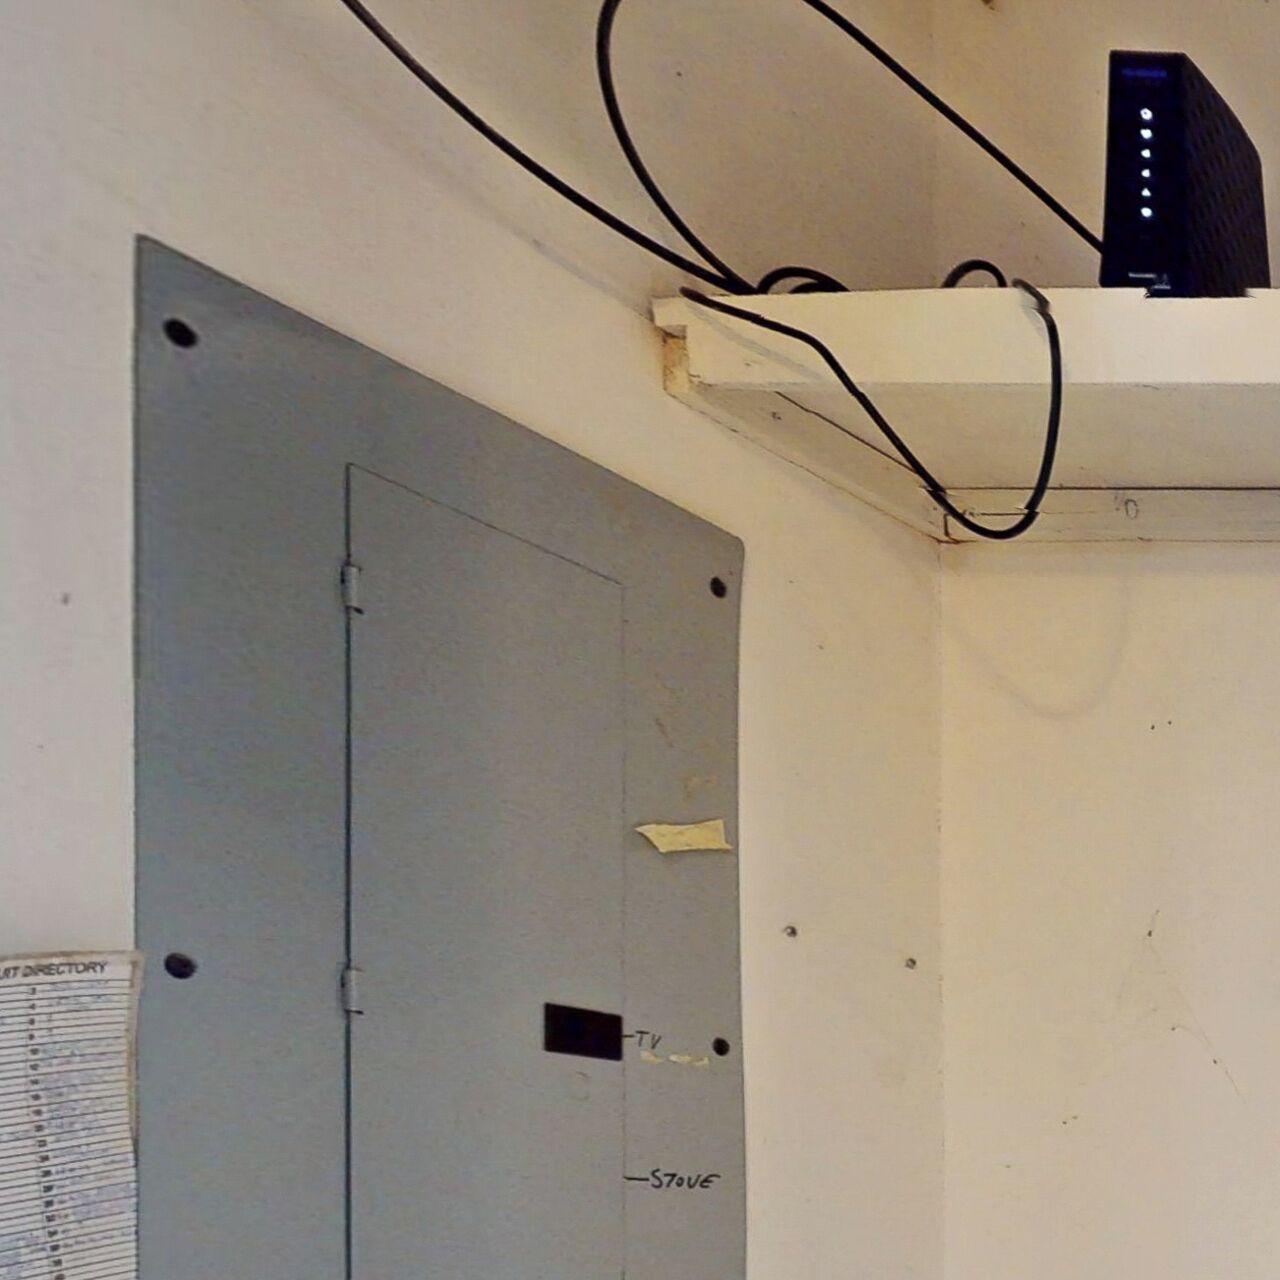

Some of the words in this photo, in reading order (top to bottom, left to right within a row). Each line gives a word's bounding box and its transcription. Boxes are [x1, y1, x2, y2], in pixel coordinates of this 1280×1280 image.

[21, 961, 108, 978] DIRECTORY
[635, 1030, 662, 1050] TV
[651, 1168, 721, 1190] STOVE
